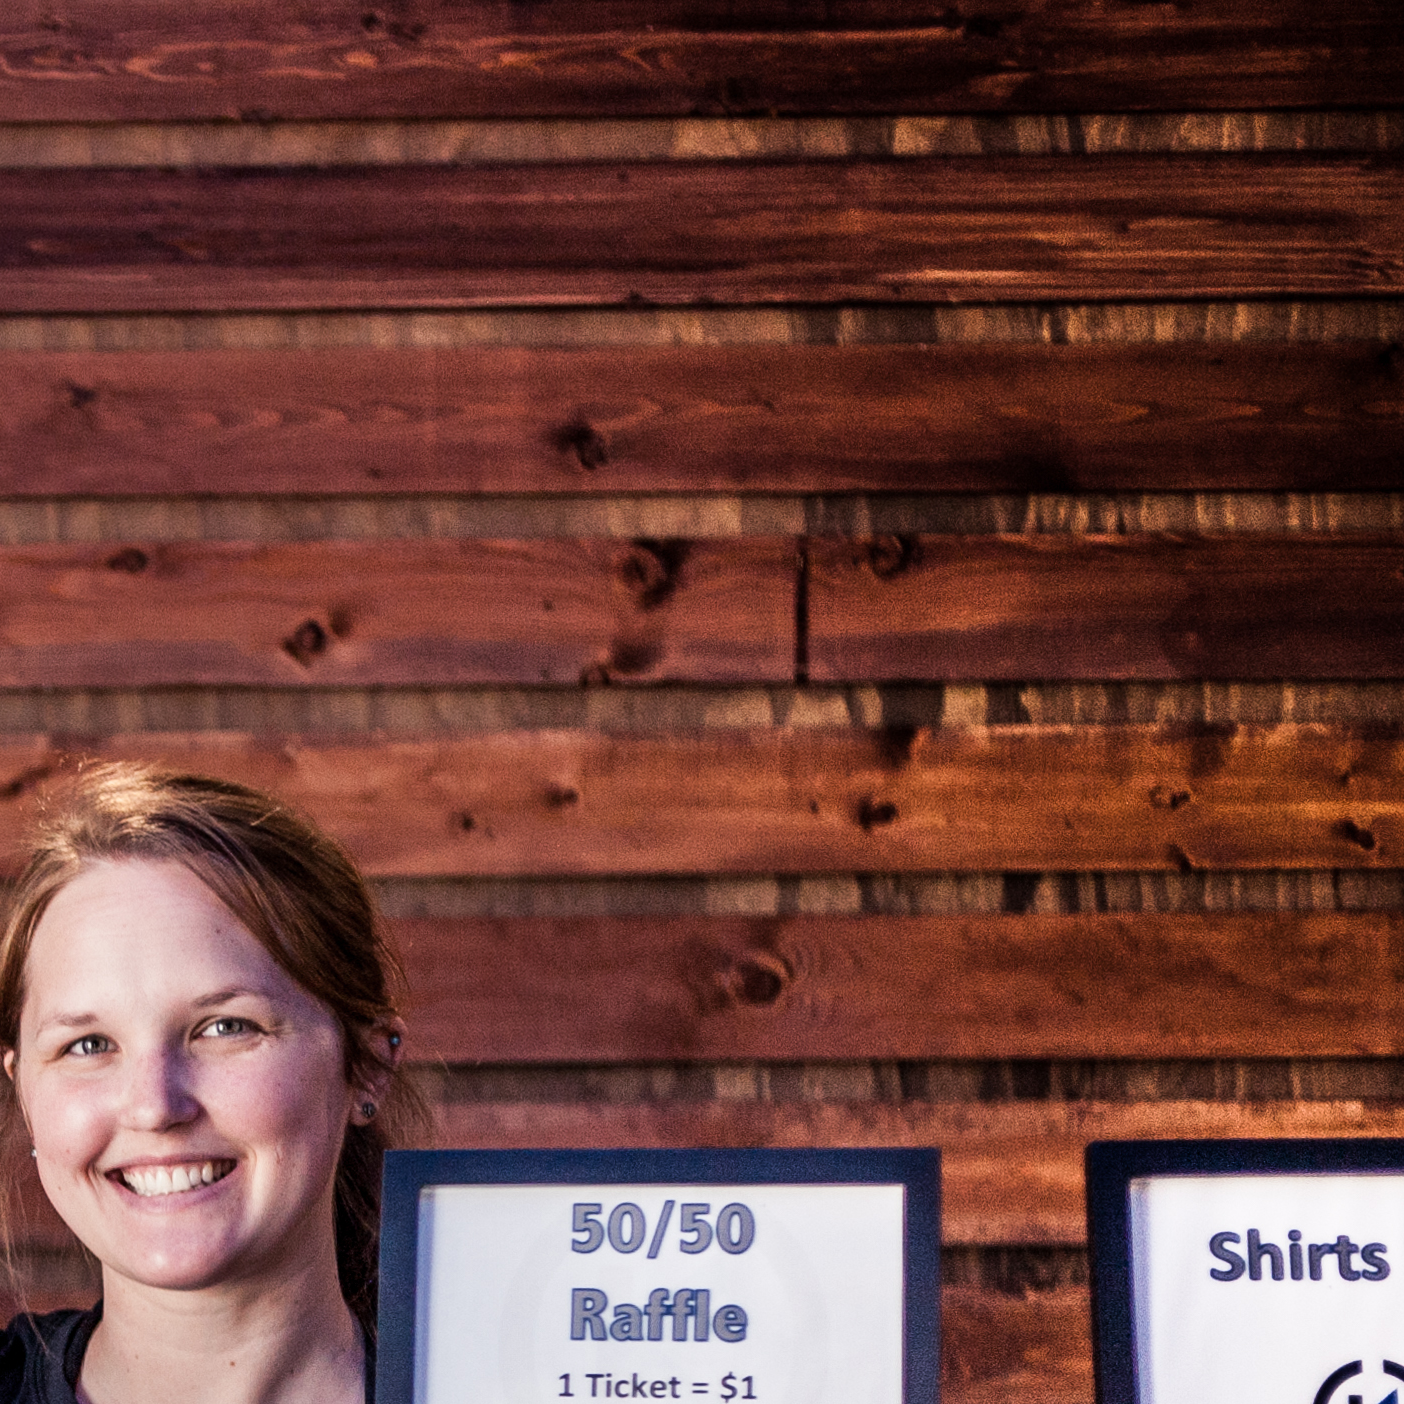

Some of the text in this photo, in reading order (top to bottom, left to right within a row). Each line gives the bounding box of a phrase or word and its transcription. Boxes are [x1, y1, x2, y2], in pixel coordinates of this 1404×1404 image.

[571, 1200, 756, 1259] 50/50
[1208, 1228, 1391, 1282] Shirts
[570, 1288, 748, 1343] Raffle
[559, 1372, 757, 1403] 1 Ticket = $1
